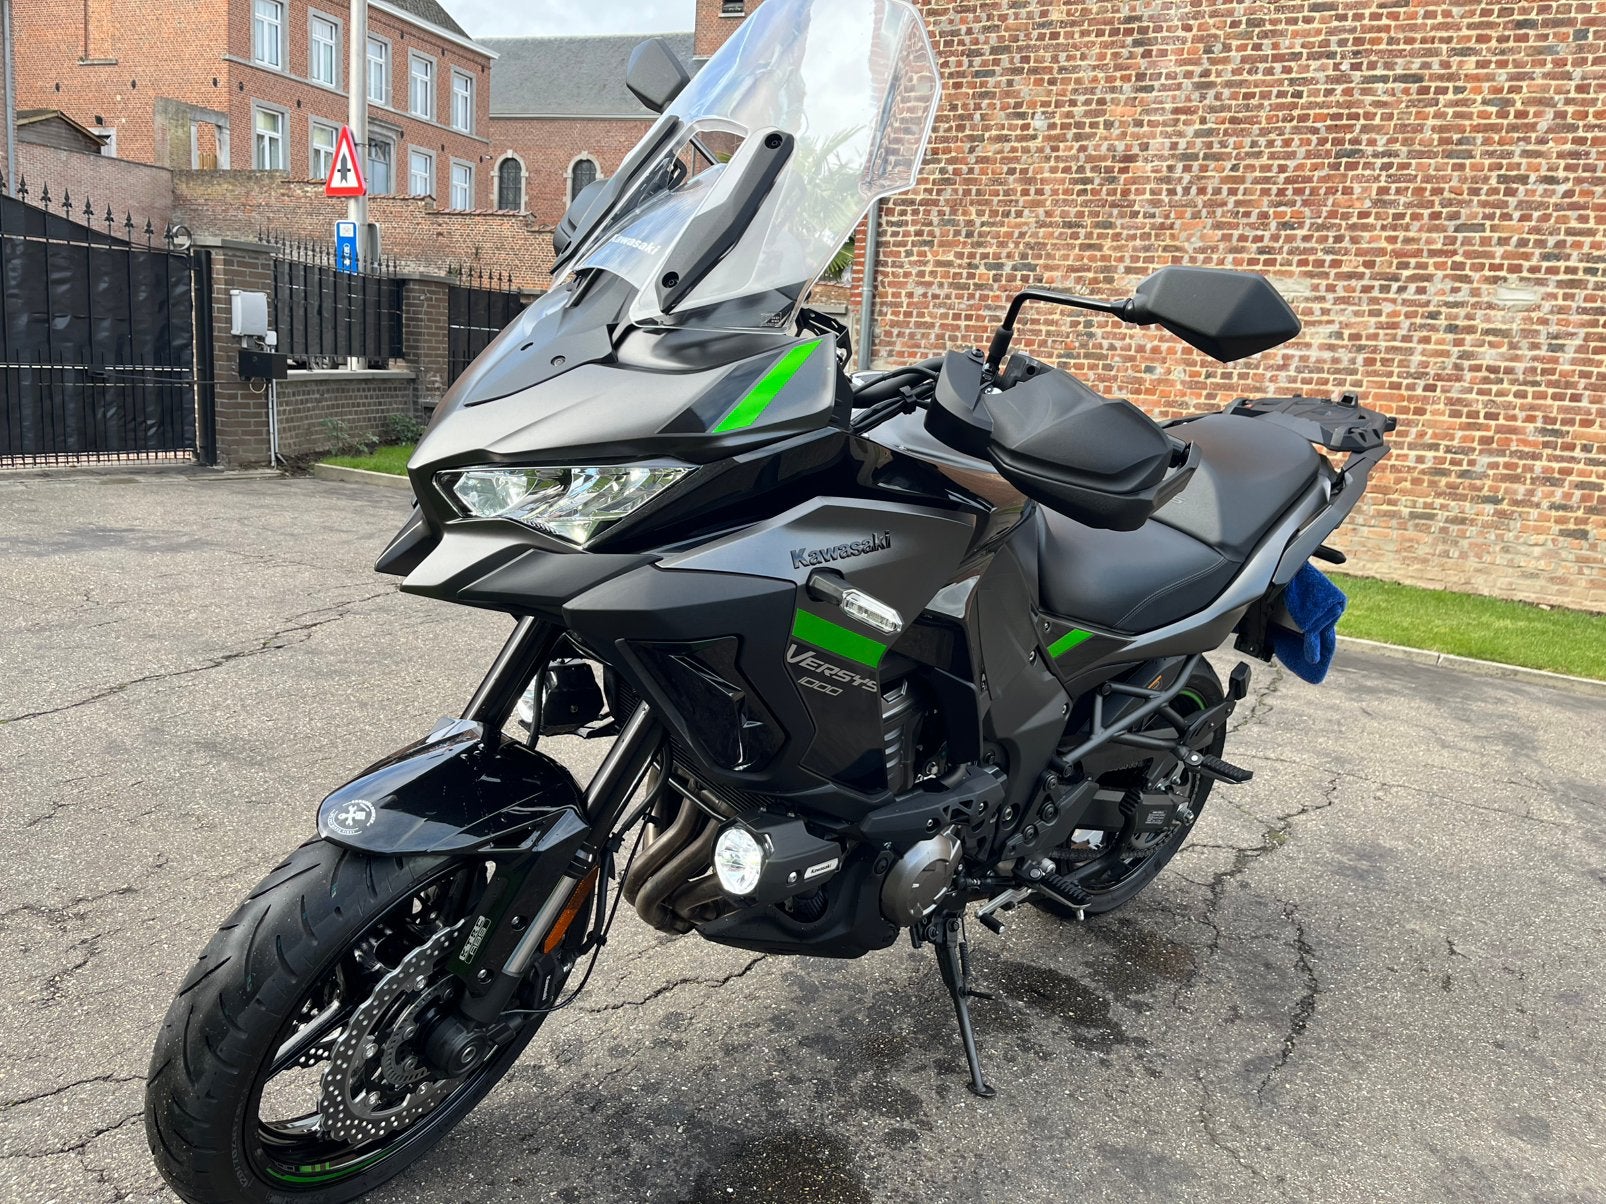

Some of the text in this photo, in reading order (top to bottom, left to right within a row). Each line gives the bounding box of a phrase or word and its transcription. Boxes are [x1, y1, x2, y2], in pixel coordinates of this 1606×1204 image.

[790, 530, 892, 569] Kawasaki
[786, 643, 878, 692] VERSYS
[798, 676, 844, 696] 1000
